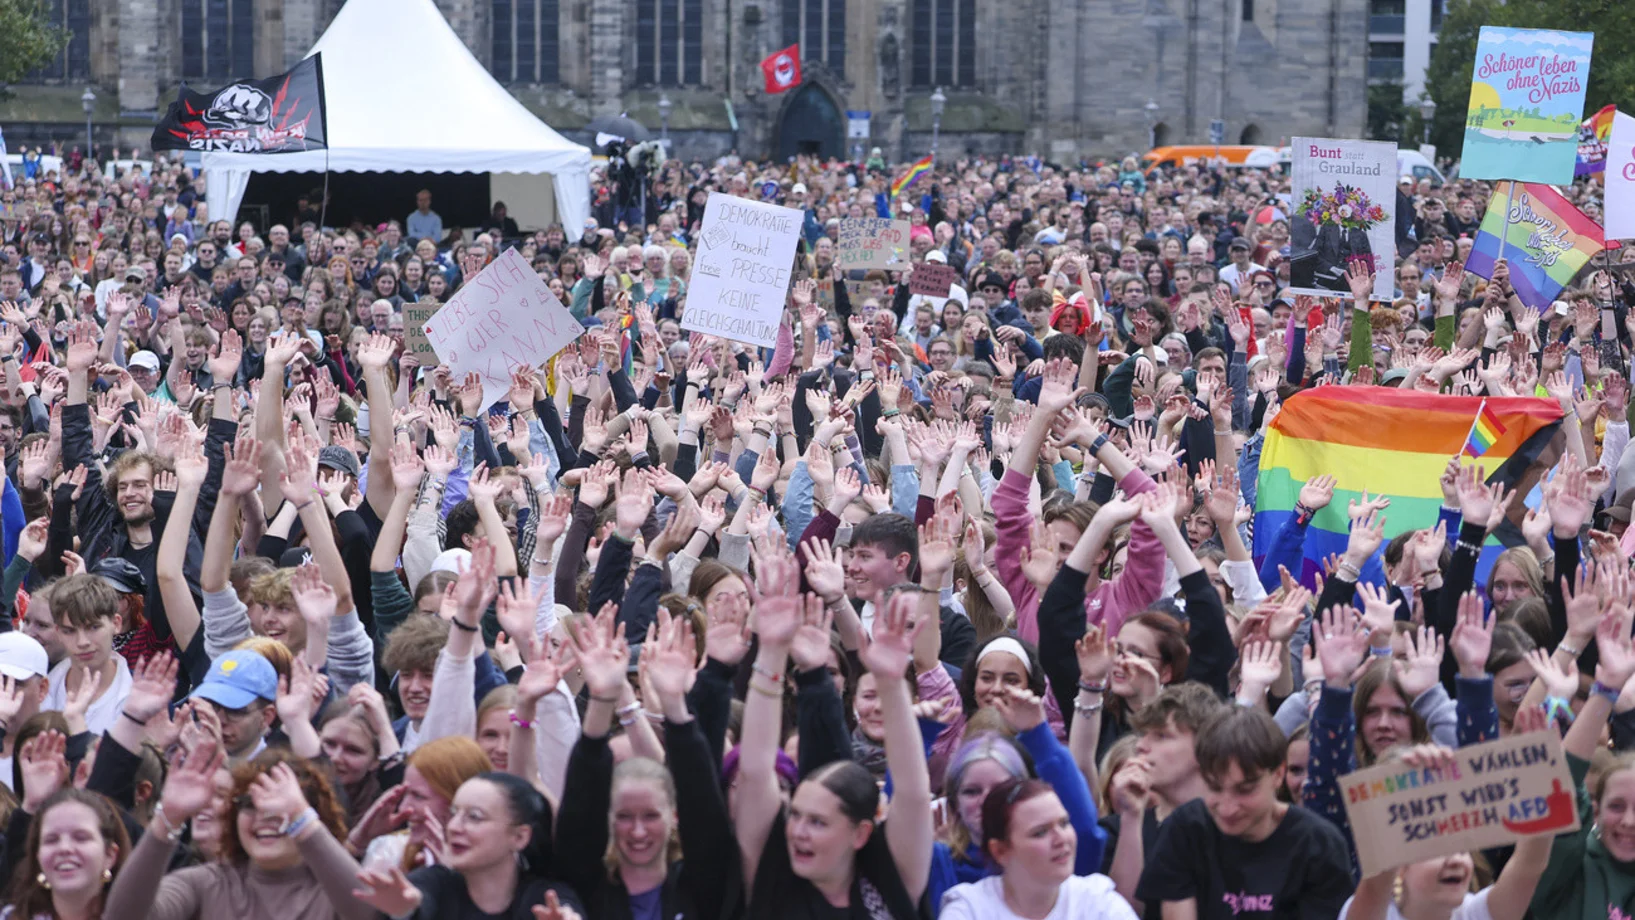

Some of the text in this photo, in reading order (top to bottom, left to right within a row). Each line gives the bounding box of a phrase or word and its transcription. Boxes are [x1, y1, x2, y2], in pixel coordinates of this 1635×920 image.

[1478, 52, 1577, 79] Schöner leben
[1506, 71, 1581, 104] ohne Nazis
[1309, 145, 1365, 160] Bunt statt
[1319, 161, 1381, 176] Grauland
[719, 203, 793, 234] DEMOKRATIE
[731, 230, 771, 257] braucht
[699, 255, 722, 274] freie
[731, 257, 787, 289] PRESSE
[407, 309, 431, 321] THIS
[430, 257, 526, 345] LIEBE SICH
[718, 288, 761, 313] KEINE
[467, 309, 509, 353] WER
[684, 308, 778, 342] GLEICHSCHALTUNG
[476, 312, 557, 389] KANN
[1348, 743, 1557, 804] DEMOKRATIE WÄHLEN,
[1388, 778, 1519, 826] SONST WIRD'S
